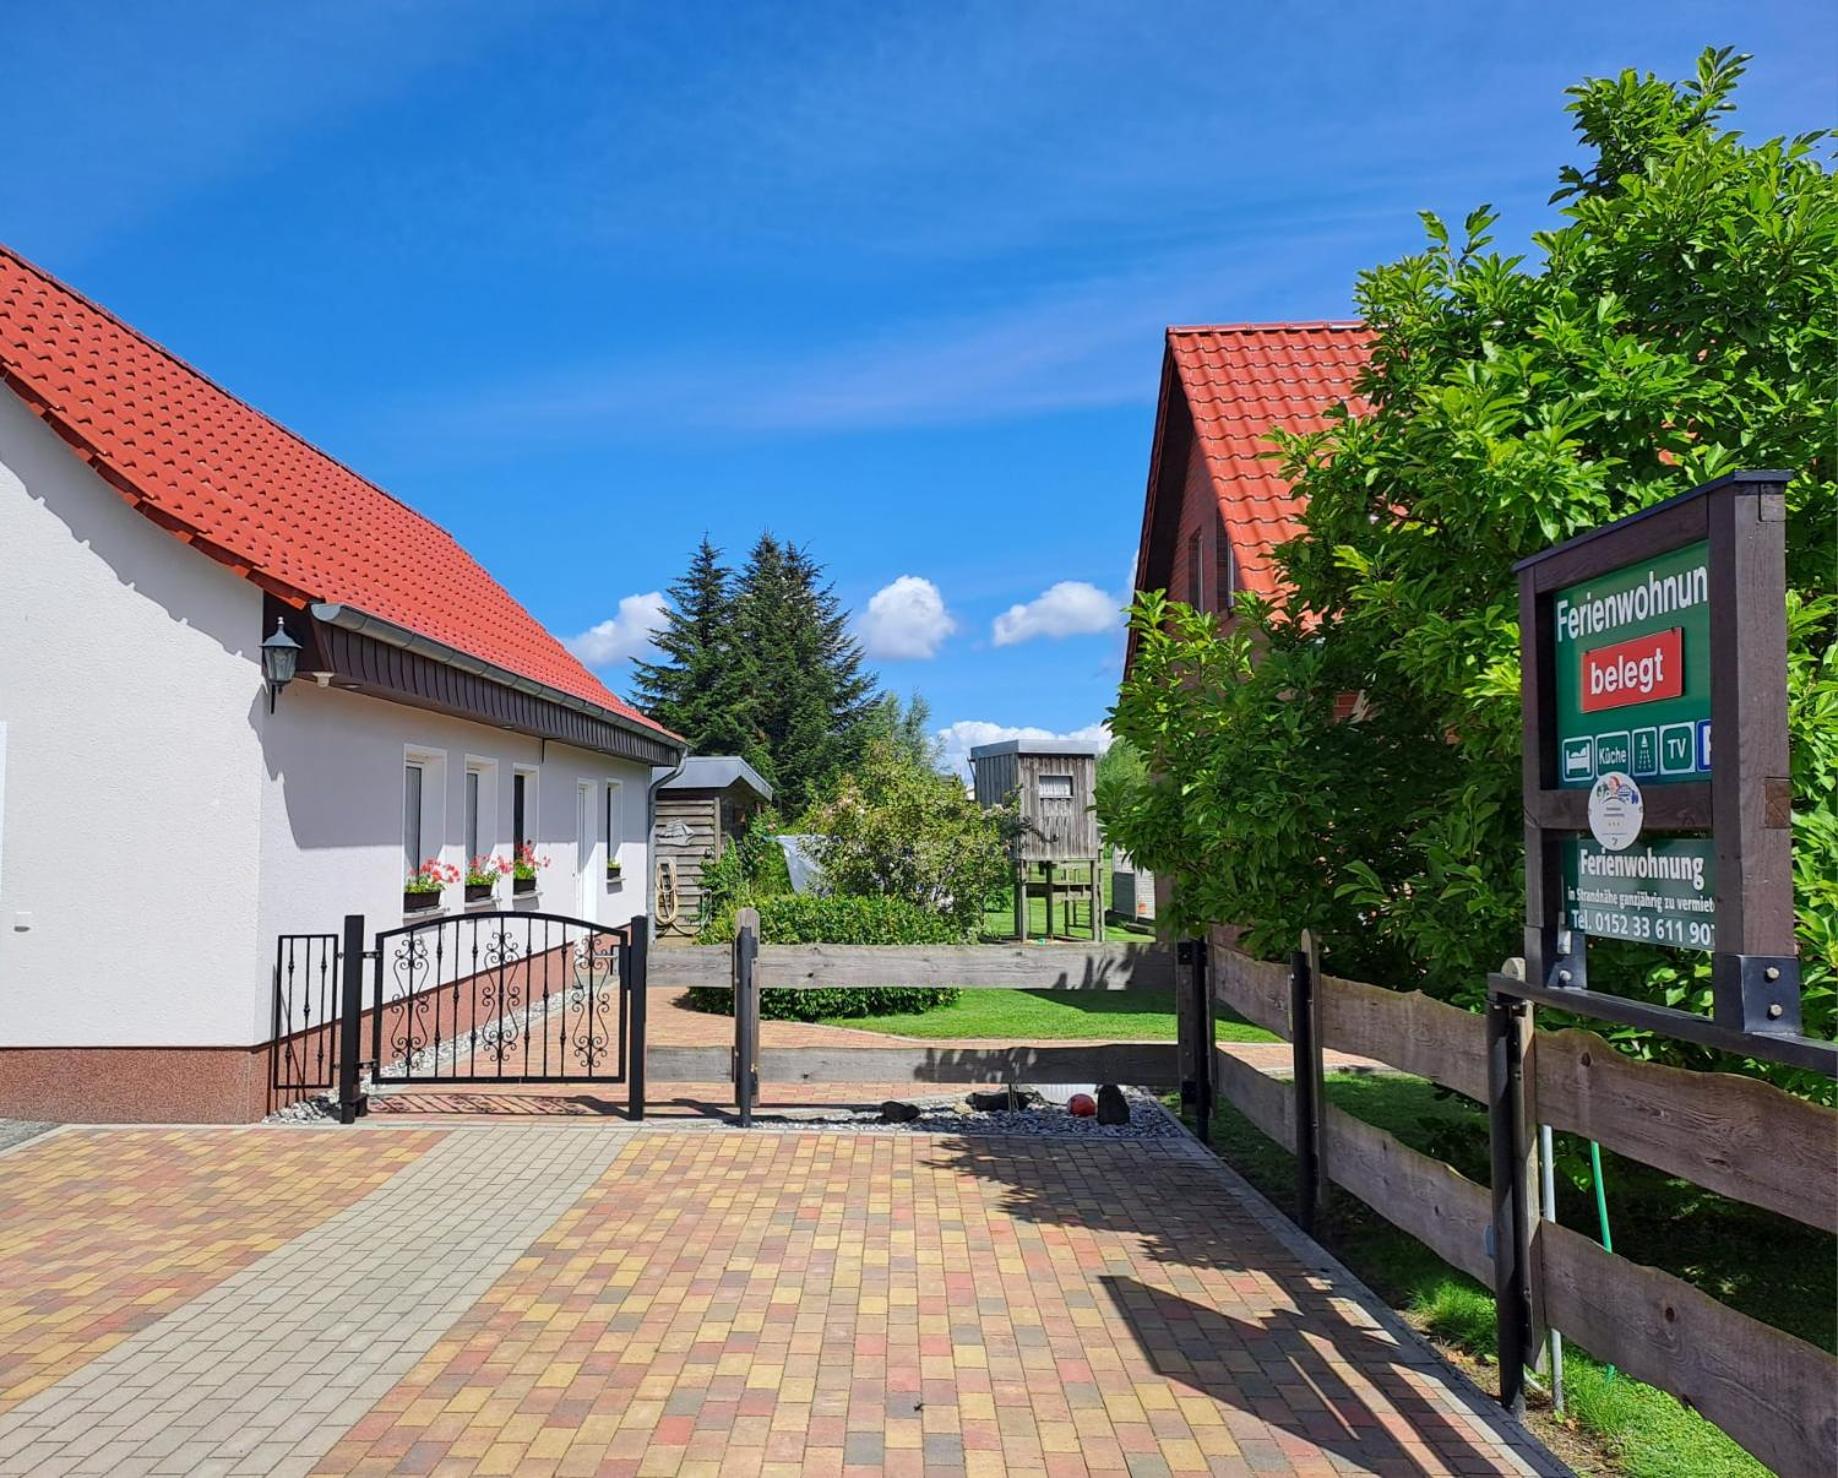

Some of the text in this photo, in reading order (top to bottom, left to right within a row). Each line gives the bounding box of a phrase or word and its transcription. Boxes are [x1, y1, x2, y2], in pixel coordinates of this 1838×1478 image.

[1556, 566, 1708, 643] Ferienwohnun
[1590, 648, 1664, 695] belegt
[1599, 746, 1627, 765] Küche
[1667, 738, 1687, 760] TV
[1580, 847, 1705, 890] Ferienwohnung
[1568, 886, 1715, 913] in Strandnähe ganzjährig zu vermiet
[1571, 909, 1592, 930] Tel.
[1595, 911, 1628, 935] 0152
[1633, 915, 1650, 938] 33
[1655, 918, 1683, 943] 611
